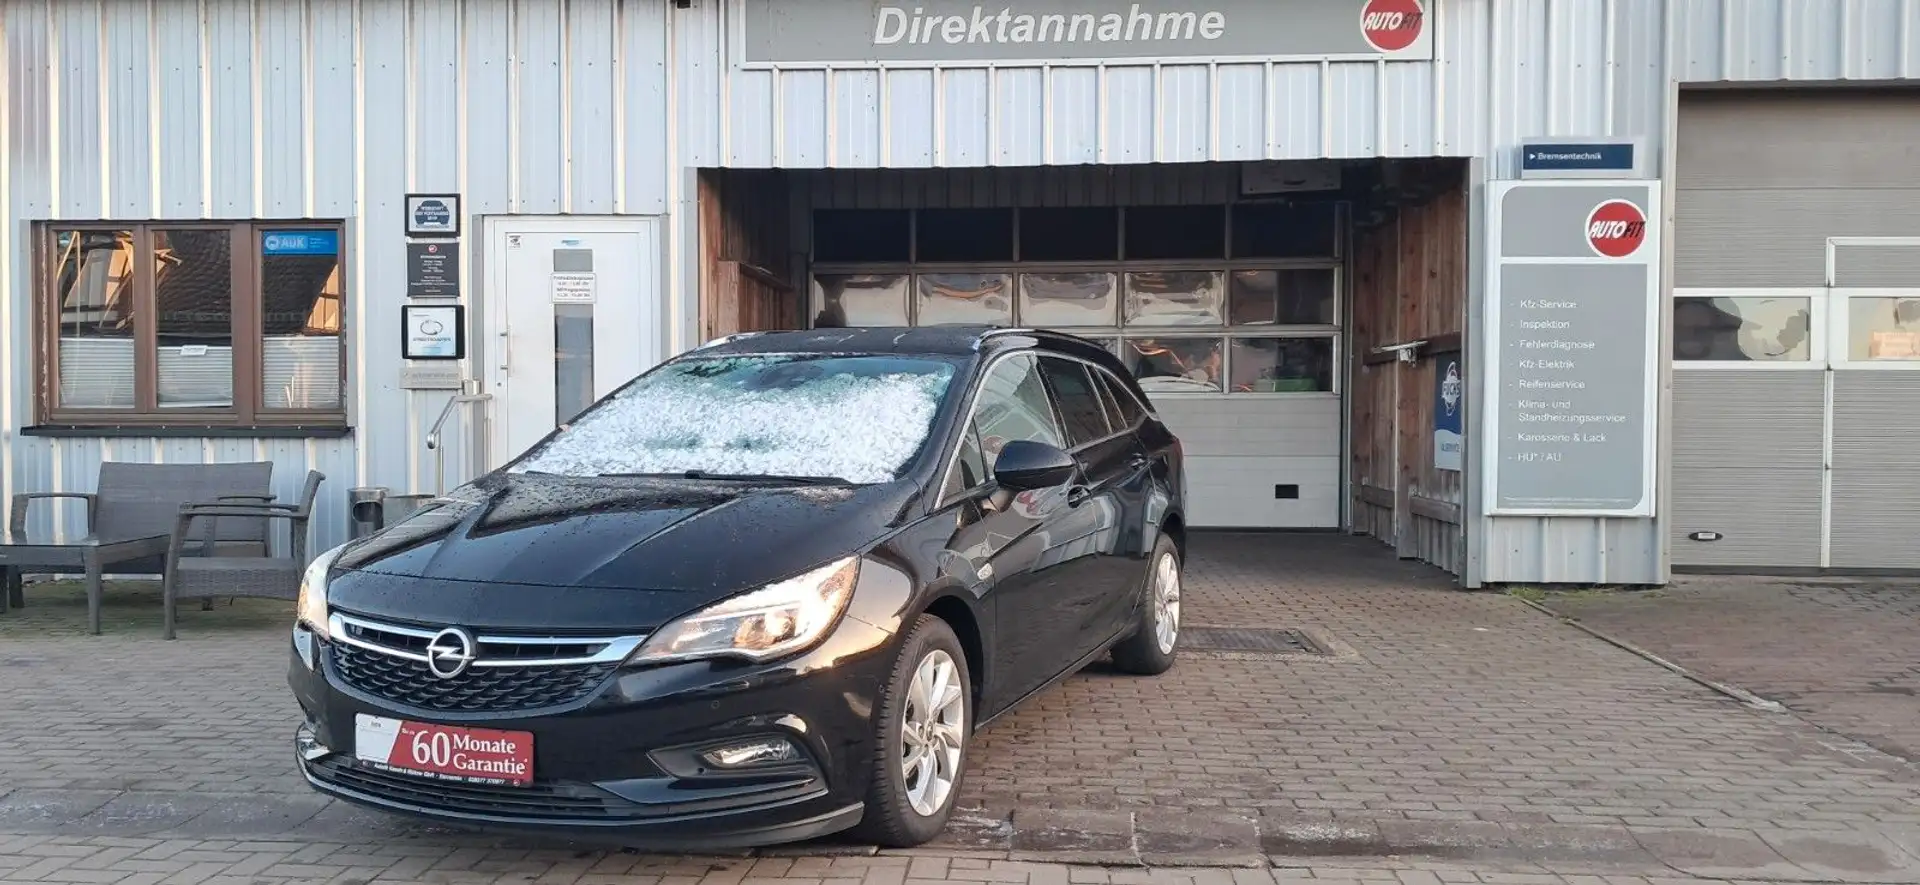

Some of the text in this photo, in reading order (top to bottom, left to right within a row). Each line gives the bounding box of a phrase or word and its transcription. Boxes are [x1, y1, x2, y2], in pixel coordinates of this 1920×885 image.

[874, 4, 1226, 45] Direktannahme
[1364, 11, 1423, 31] AUTOFIT
[1537, 152, 1602, 161] Bremsentechnik
[1589, 220, 1646, 239] AUTOFIT
[1520, 299, 1577, 309] Kfz-Service
[1520, 320, 1570, 330] Inspektion
[1520, 339, 1595, 350] Fehlerdiagnose
[1519, 359, 1576, 369] Kfz-Elektrik
[1519, 379, 1586, 389] Reifenservice
[1518, 399, 1571, 409] Klima- und
[1518, 412, 1626, 424] Standheizungsservice
[1573, 432, 1580, 442] &
[1583, 432, 1607, 442] Lack
[411, 730, 516, 767] 60 Monate
